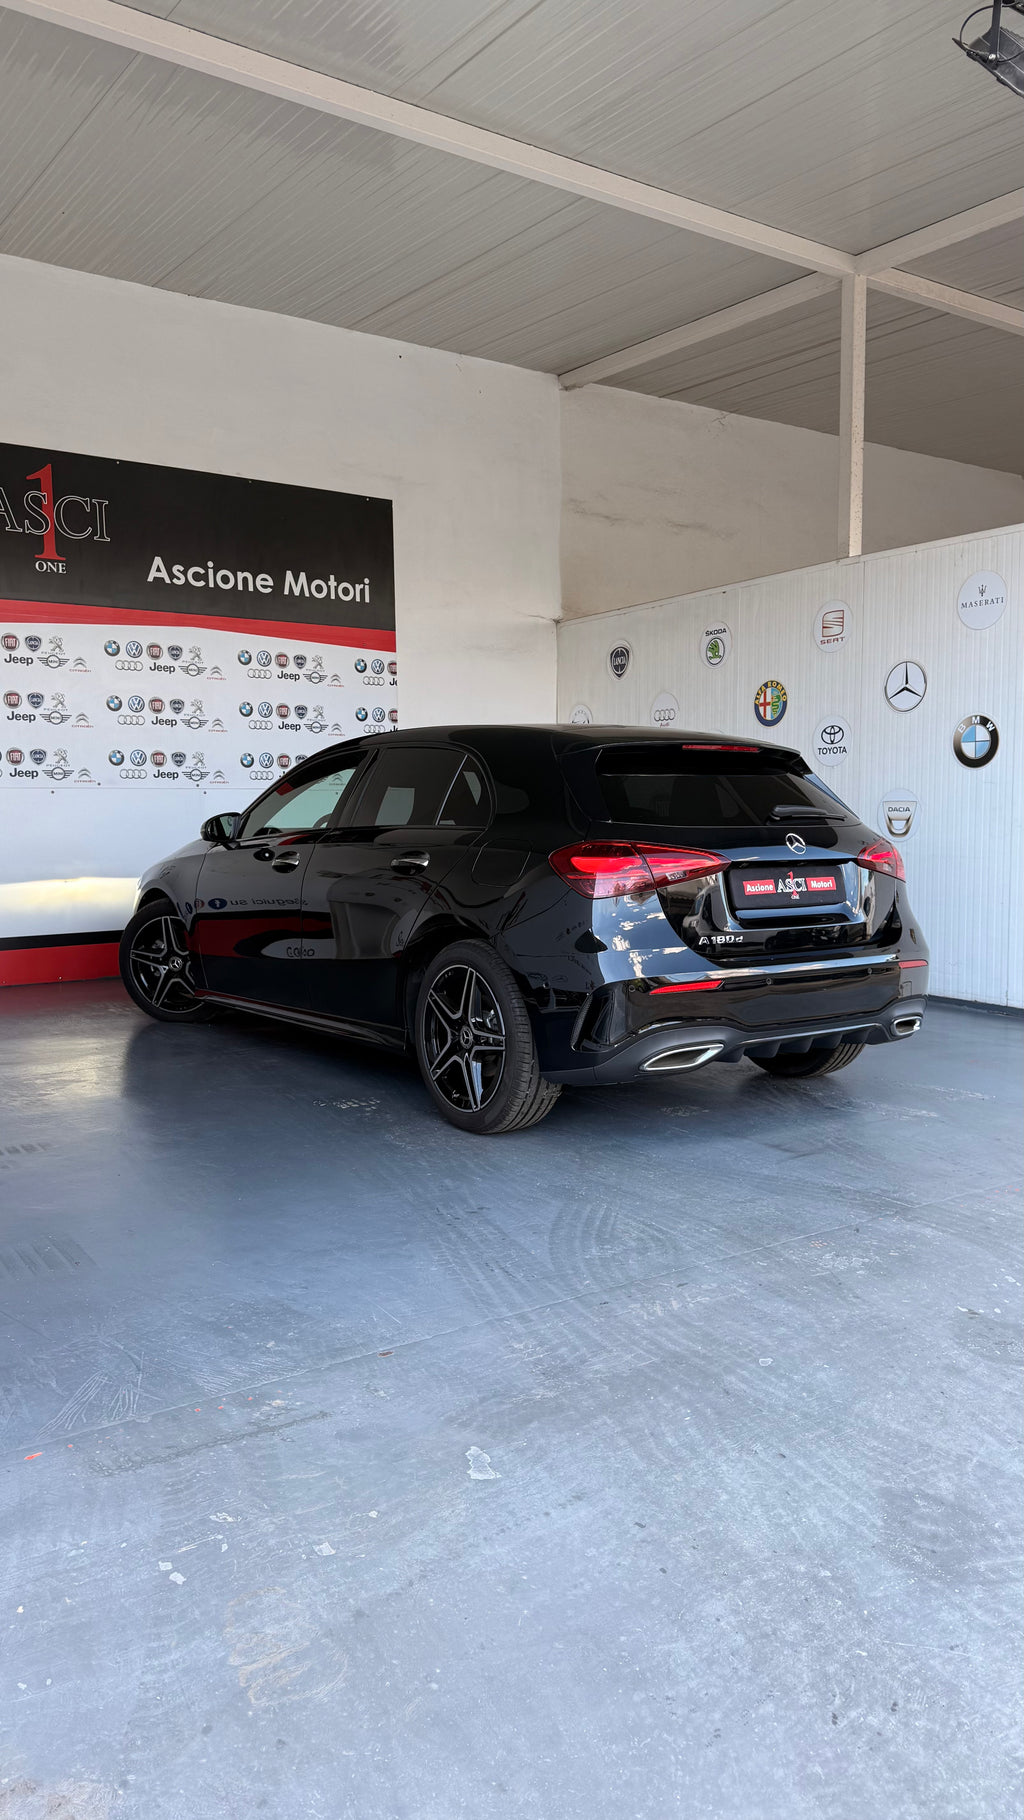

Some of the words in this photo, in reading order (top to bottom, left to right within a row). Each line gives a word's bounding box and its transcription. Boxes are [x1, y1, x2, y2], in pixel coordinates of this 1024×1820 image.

[35, 560, 67, 574] ONE
[147, 556, 274, 594] Ascione
[283, 570, 371, 603] Motori
[961, 596, 1004, 609] MASERATI
[820, 636, 845, 645] SEAT
[4, 654, 34, 666] Jeep
[150, 662, 176, 674] Jeep
[277, 671, 300, 682] Jeep
[755, 686, 765, 704] ALFA
[767, 681, 787, 702] ROMEO
[7, 711, 36, 723] Jeep
[152, 715, 177, 727] Jeep
[278, 721, 301, 733] Jeep
[957, 716, 995, 734] BMW
[818, 746, 847, 755] TOYOTA
[9, 768, 39, 780] Jeep
[153, 769, 179, 780] Jeep
[746, 883, 773, 893] Ascione
[777, 878, 807, 893] ASCI
[811, 879, 832, 889] Motori
